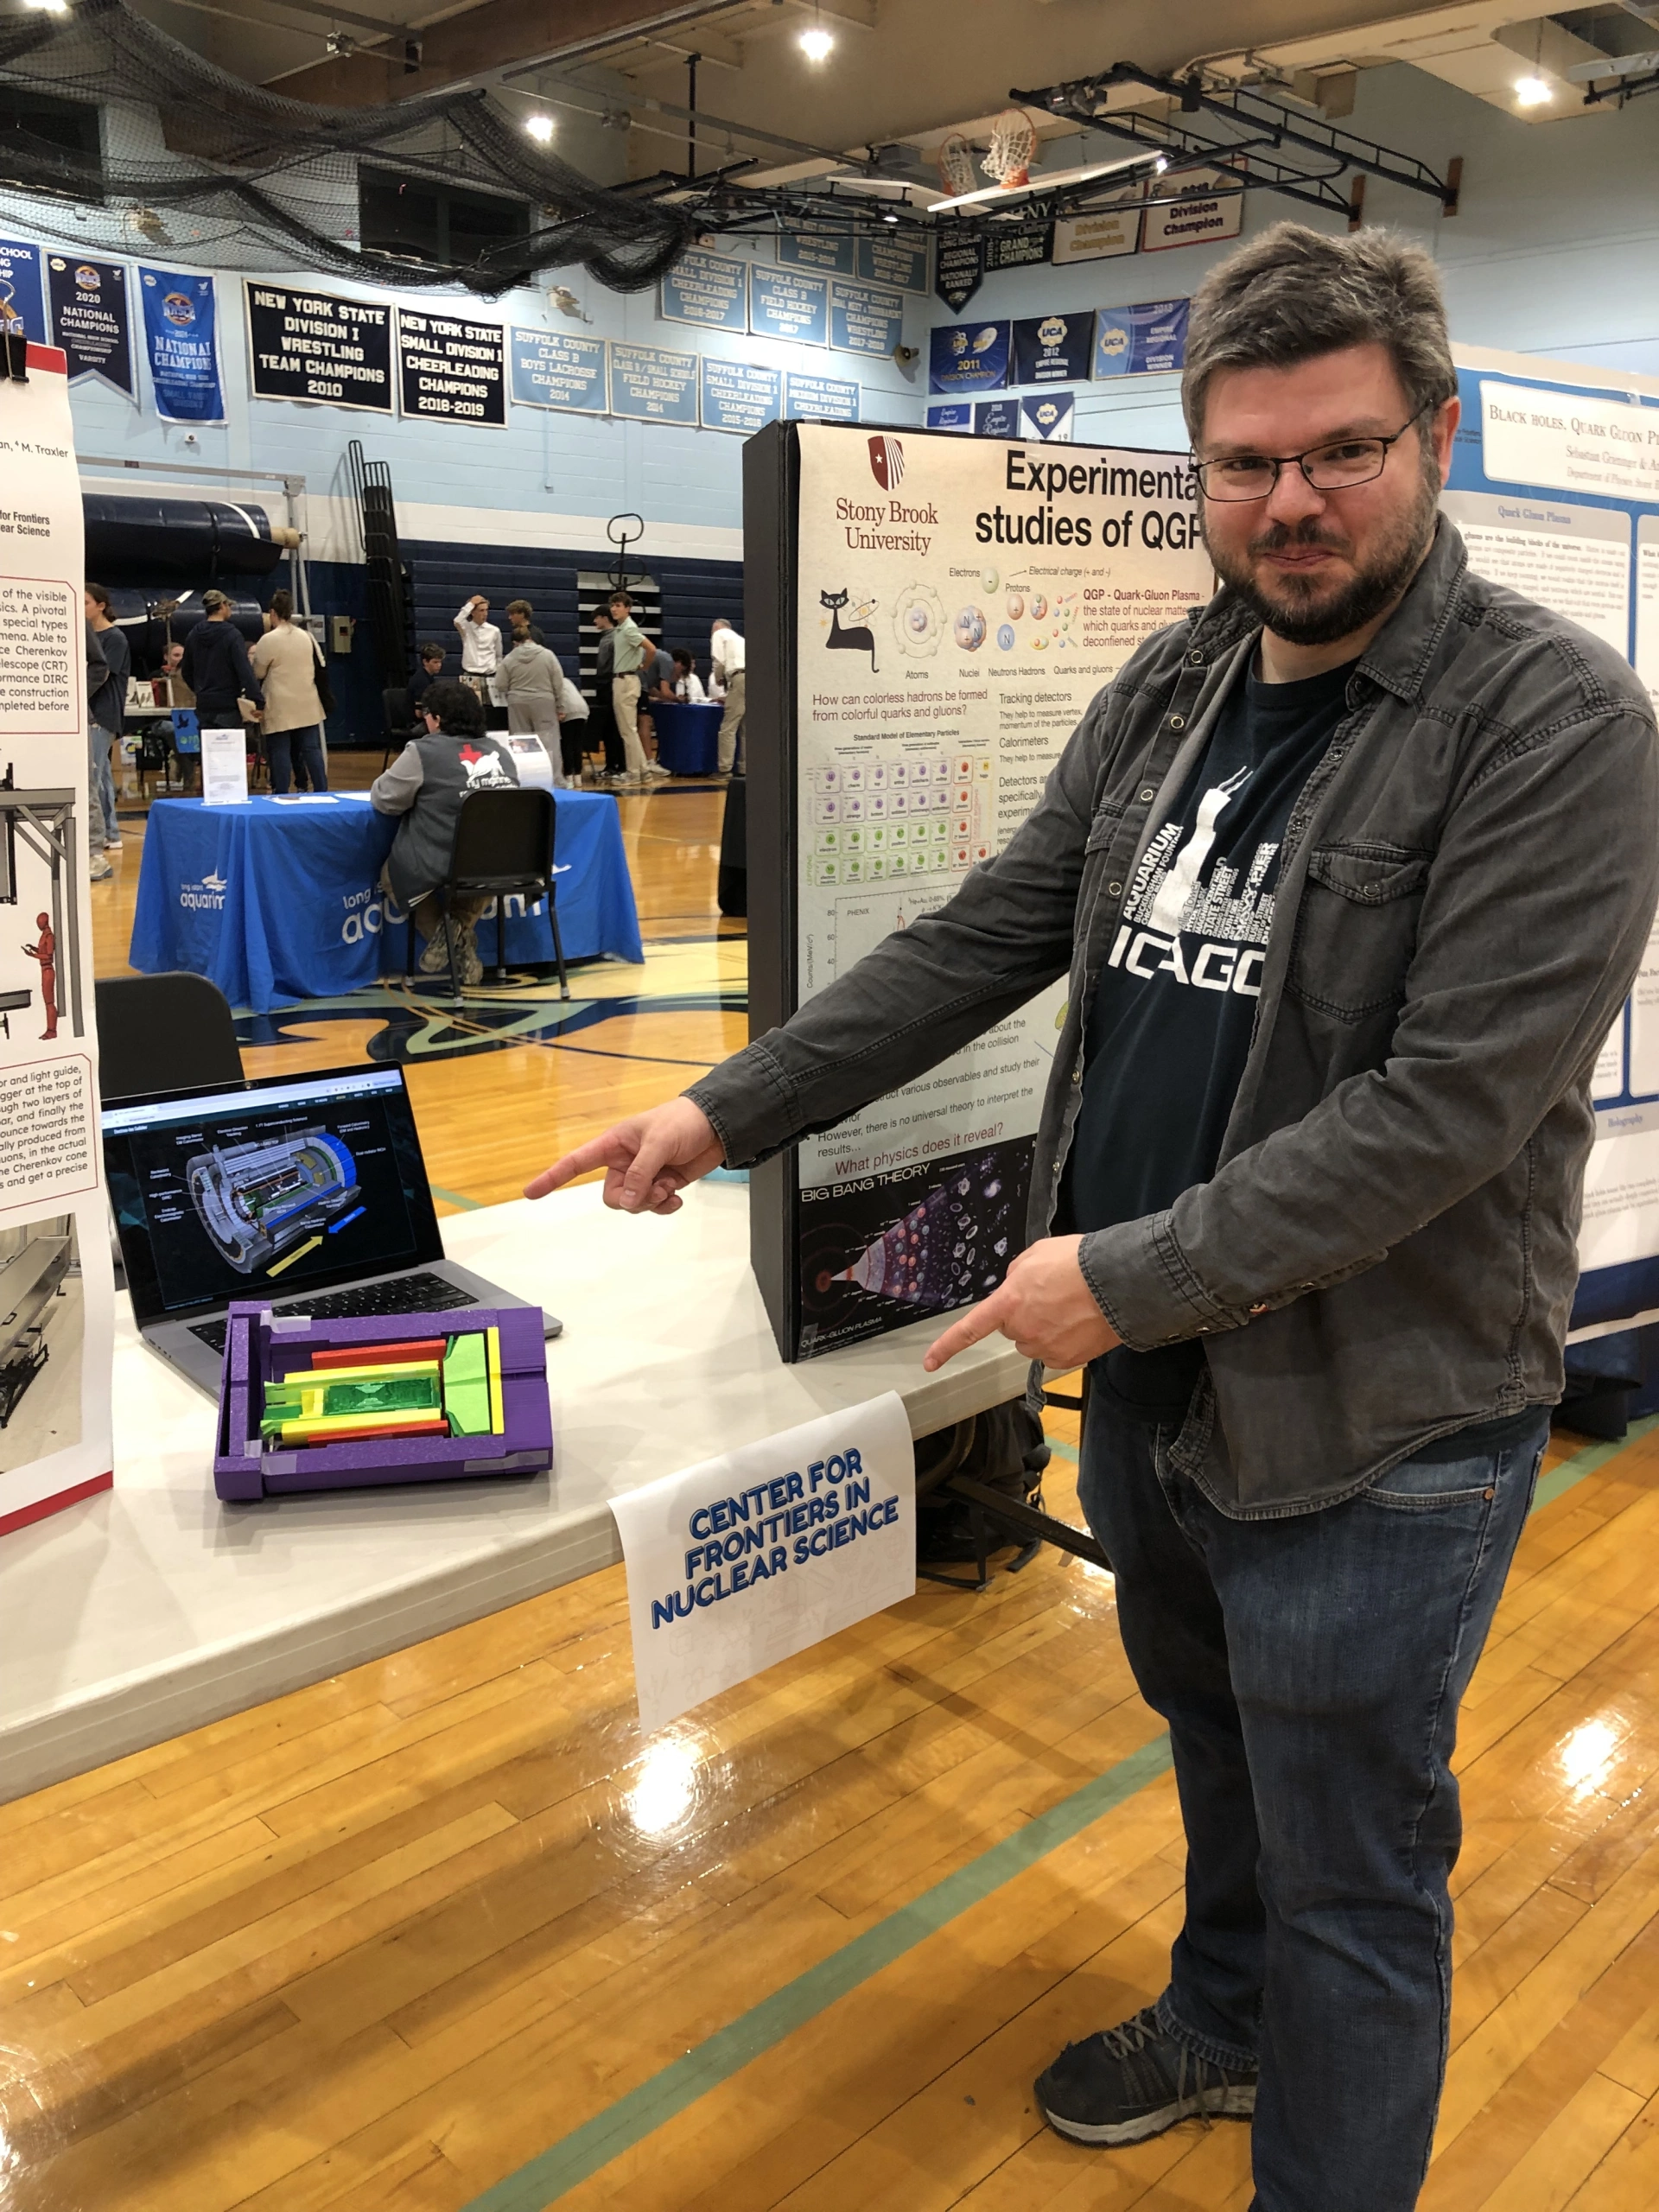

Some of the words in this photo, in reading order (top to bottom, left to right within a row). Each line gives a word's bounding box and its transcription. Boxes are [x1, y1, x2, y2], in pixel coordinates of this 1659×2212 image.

[1170, 201, 1218, 219] Division
[1163, 217, 1224, 236] Champion
[1000, 238, 1029, 251] GRAND
[1000, 246, 1043, 264] CHAMPIONS
[76, 292, 101, 304] 2020
[63, 307, 115, 322] NATIONAL
[254, 290, 286, 310] NEW
[292, 297, 333, 316] YORK
[339, 305, 385, 325] STATE
[60, 318, 119, 334] CHAMPIONS
[284, 316, 347, 339] DIVISION
[400, 315, 427, 331] NEW
[429, 321, 463, 337] YORK
[465, 327, 502, 343] STATE
[1042, 327, 1063, 336] UCA
[281, 336, 364, 361] WRESTLING
[400, 334, 442, 354] SMALL
[446, 342, 494, 360] DIVISION
[497, 349, 503, 362] 1
[515, 331, 560, 347] SUFFOLK
[563, 338, 600, 353] COUNTY
[538, 348, 569, 361] CLASS
[573, 354, 579, 363] B
[957, 359, 980, 370] 2011
[259, 353, 301, 372] TEAM
[305, 359, 385, 383] CHAMPIONS
[406, 355, 499, 380] CHEERLEADING
[521, 358, 546, 371] BOYS
[550, 363, 597, 378] LACROSSE
[308, 379, 343, 397] 2010
[418, 377, 488, 398] CHAMPIONS
[531, 373, 587, 390] CHAMPIONS
[550, 389, 570, 401] 2014
[418, 397, 484, 416] 2018-2019
[1490, 404, 1527, 424] BLACK
[1571, 418, 1605, 437] QUARK
[22, 442, 33, 453] M.
[35, 445, 68, 457] Traxler
[1006, 449, 1197, 501] Experimenta
[13, 512, 50, 524] Frontiers
[836, 497, 886, 527] Stony
[889, 500, 938, 525] Brook
[17, 524, 50, 537] Science
[976, 505, 1092, 546] studies
[1101, 510, 1133, 548] of
[844, 526, 931, 556] University
[950, 568, 980, 577] Electrons
[1029, 566, 1058, 575] Electrical
[1060, 567, 1082, 577] charge
[3, 588, 13, 598] of
[16, 589, 32, 600] the
[36, 591, 67, 601] visible
[1005, 583, 1030, 593] Protons
[1084, 589, 1103, 601] QGP
[1114, 588, 1169, 601] Quark-Gluon
[1172, 590, 1200, 601] Plasma
[22, 604, 29, 613] A
[33, 605, 66, 616] pivotal
[1084, 606, 1096, 616] the
[1099, 607, 1120, 616] state
[1122, 606, 1131, 616] of
[1133, 607, 1162, 616] nuclear
[3, 619, 37, 629] special
[41, 620, 68, 632] types
[16, 646, 67, 657] Cherenkov
[41, 661, 67, 672] (CRT)
[905, 669, 929, 680] Atoms
[959, 669, 980, 677] Nuclei
[988, 667, 1016, 677] Neutrons
[1018, 666, 1046, 677] Hadrons
[1053, 665, 1076, 675] Quarks
[1078, 666, 1090, 675] and
[1091, 664, 1114, 676] gluons
[43, 675, 68, 684] DIRC
[9, 688, 69, 697] construction
[812, 694, 839, 707] How
[842, 695, 861, 705] can
[863, 691, 906, 704] colorless
[907, 690, 943, 702] hadrons
[944, 690, 957, 702] be
[958, 689, 987, 701] formed
[1000, 694, 1033, 705] Tracking
[1035, 692, 1071, 702] detectors
[39, 702, 69, 711] before
[812, 709, 840, 721] from
[842, 709, 880, 721] colorful
[881, 707, 911, 720] quarks
[913, 706, 931, 717] and
[933, 704, 967, 718] gluons?
[906, 731, 935, 740] Elementary
[999, 736, 1049, 747] Calorimeters
[1123, 823, 1180, 920] AQUARIUM
[343, 887, 371, 910] long
[1134, 867, 1163, 923] BUCKINGHAM
[1202, 905, 1220, 936] STATE
[1212, 868, 1233, 904] STREET
[1108, 925, 1267, 996] ICAGO
[10, 1074, 28, 1086] and
[30, 1071, 51, 1083] light
[53, 1065, 81, 1079] guide,
[901, 1082, 931, 1097] various
[932, 1071, 981, 1089] observables
[983, 1066, 997, 1077] and
[1000, 1061, 1020, 1075] study
[1023, 1057, 1039, 1068] their
[16, 1110, 35, 1122] and
[38, 1106, 66, 1119] finally
[69, 1102, 84, 1110] the
[818, 1127, 862, 1143] However,
[866, 1121, 887, 1133] there
[890, 1119, 896, 1128] is
[898, 1117, 910, 1126] no
[912, 1106, 947, 1124] universal
[950, 1101, 975, 1117] theory
[976, 1098, 985, 1107] to
[987, 1091, 1020, 1106] interpret
[1020, 1086, 1033, 1097] the
[31, 1118, 67, 1131] towards
[71, 1114, 85, 1122] the
[17, 1131, 61, 1150] produced
[65, 1126, 86, 1136] from
[29, 1148, 37, 1157] in
[41, 1145, 55, 1154] the
[58, 1138, 86, 1150] actual
[836, 1158, 869, 1175] What
[873, 1145, 919, 1169] physics
[922, 1140, 950, 1154] does
[953, 1135, 960, 1147] it
[963, 1122, 1003, 1142] reveal?
[13, 1156, 62, 1173] Cherenkov
[66, 1151, 87, 1161] cone
[801, 1187, 830, 1202] BIG
[833, 1177, 874, 1198] BANG
[876, 1163, 931, 1186] THEORY
[690, 1471, 804, 1540] CENTER
[808, 1448, 862, 1492] FOR
[685, 1491, 840, 1580] FRONTIERS
[845, 1476, 870, 1510] IN
[652, 1546, 787, 1630] NUCLEAR
[793, 1495, 899, 1565] SCIENCE
